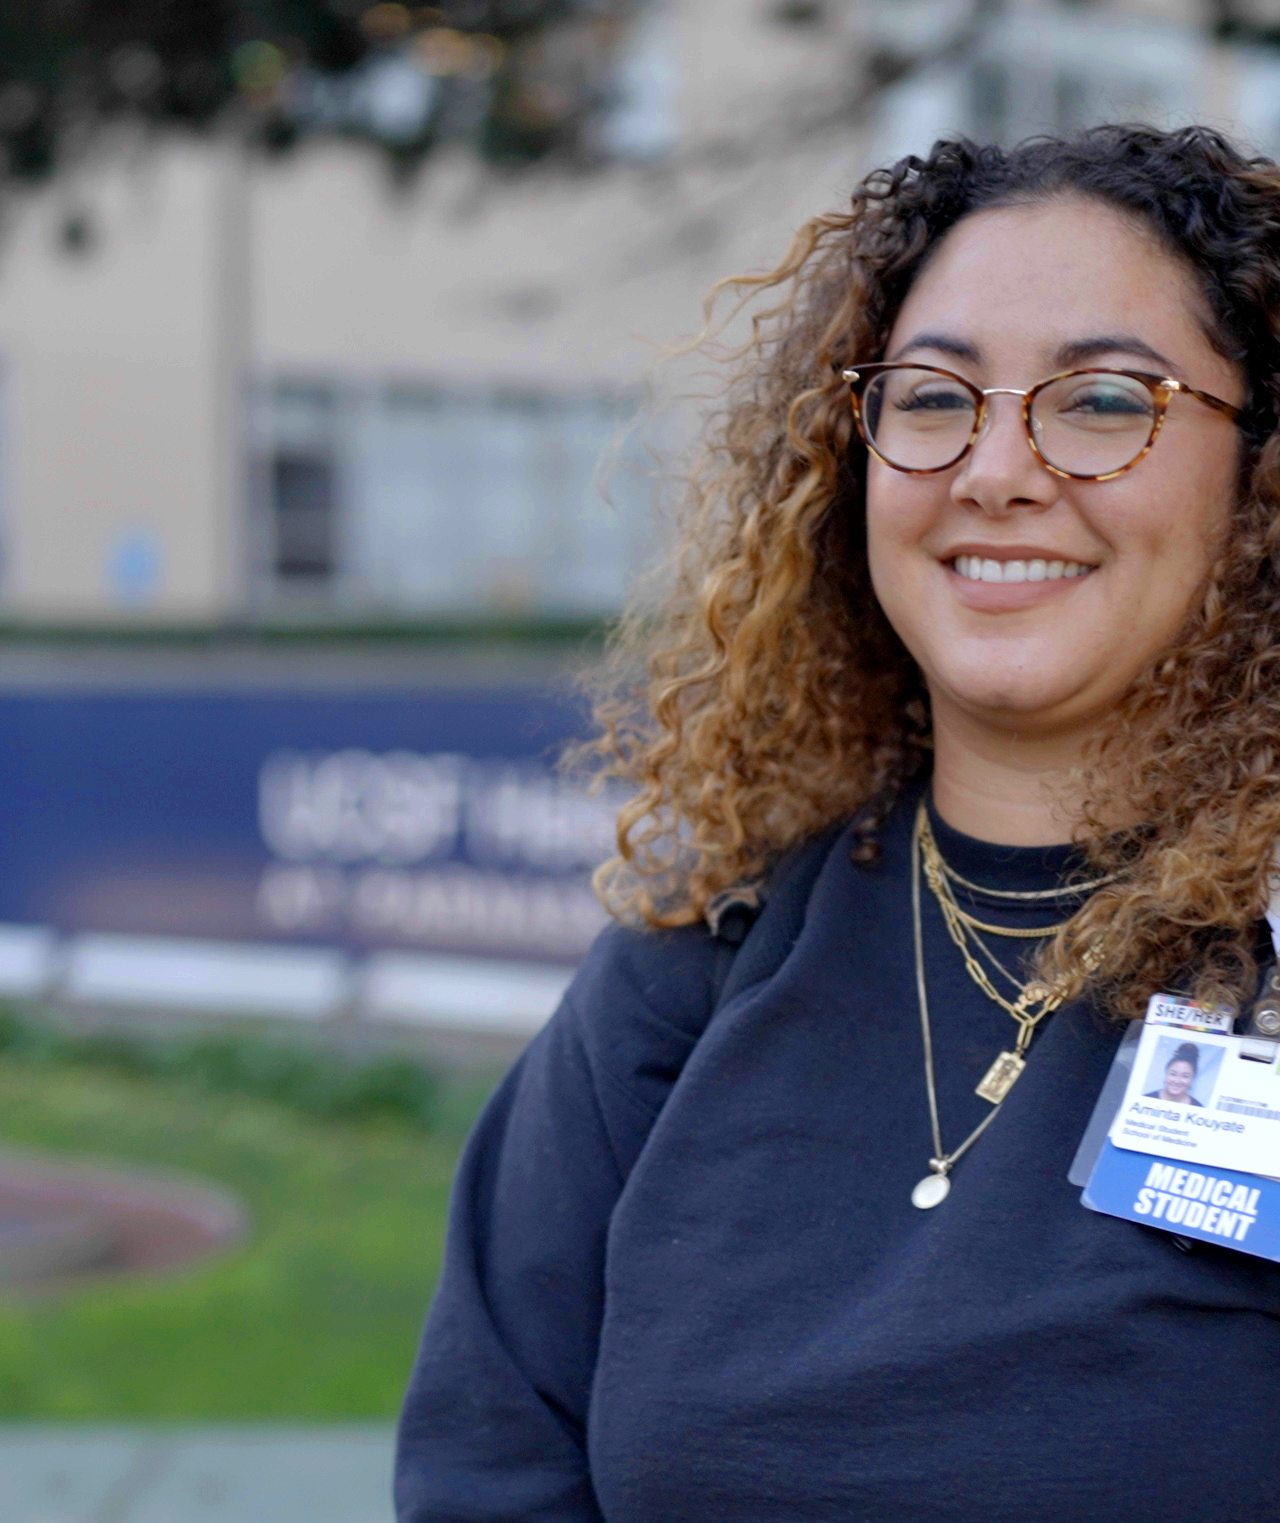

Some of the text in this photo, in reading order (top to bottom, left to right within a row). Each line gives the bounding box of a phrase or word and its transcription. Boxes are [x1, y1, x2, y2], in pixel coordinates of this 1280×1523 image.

[1155, 1004, 1223, 1025] SHE/HER
[1125, 1118, 1190, 1137] Medical Student
[1129, 1102, 1246, 1133] Aminta Kouyate
[1144, 1162, 1261, 1216] MEDICAL
[1133, 1187, 1256, 1241] STUDENT
